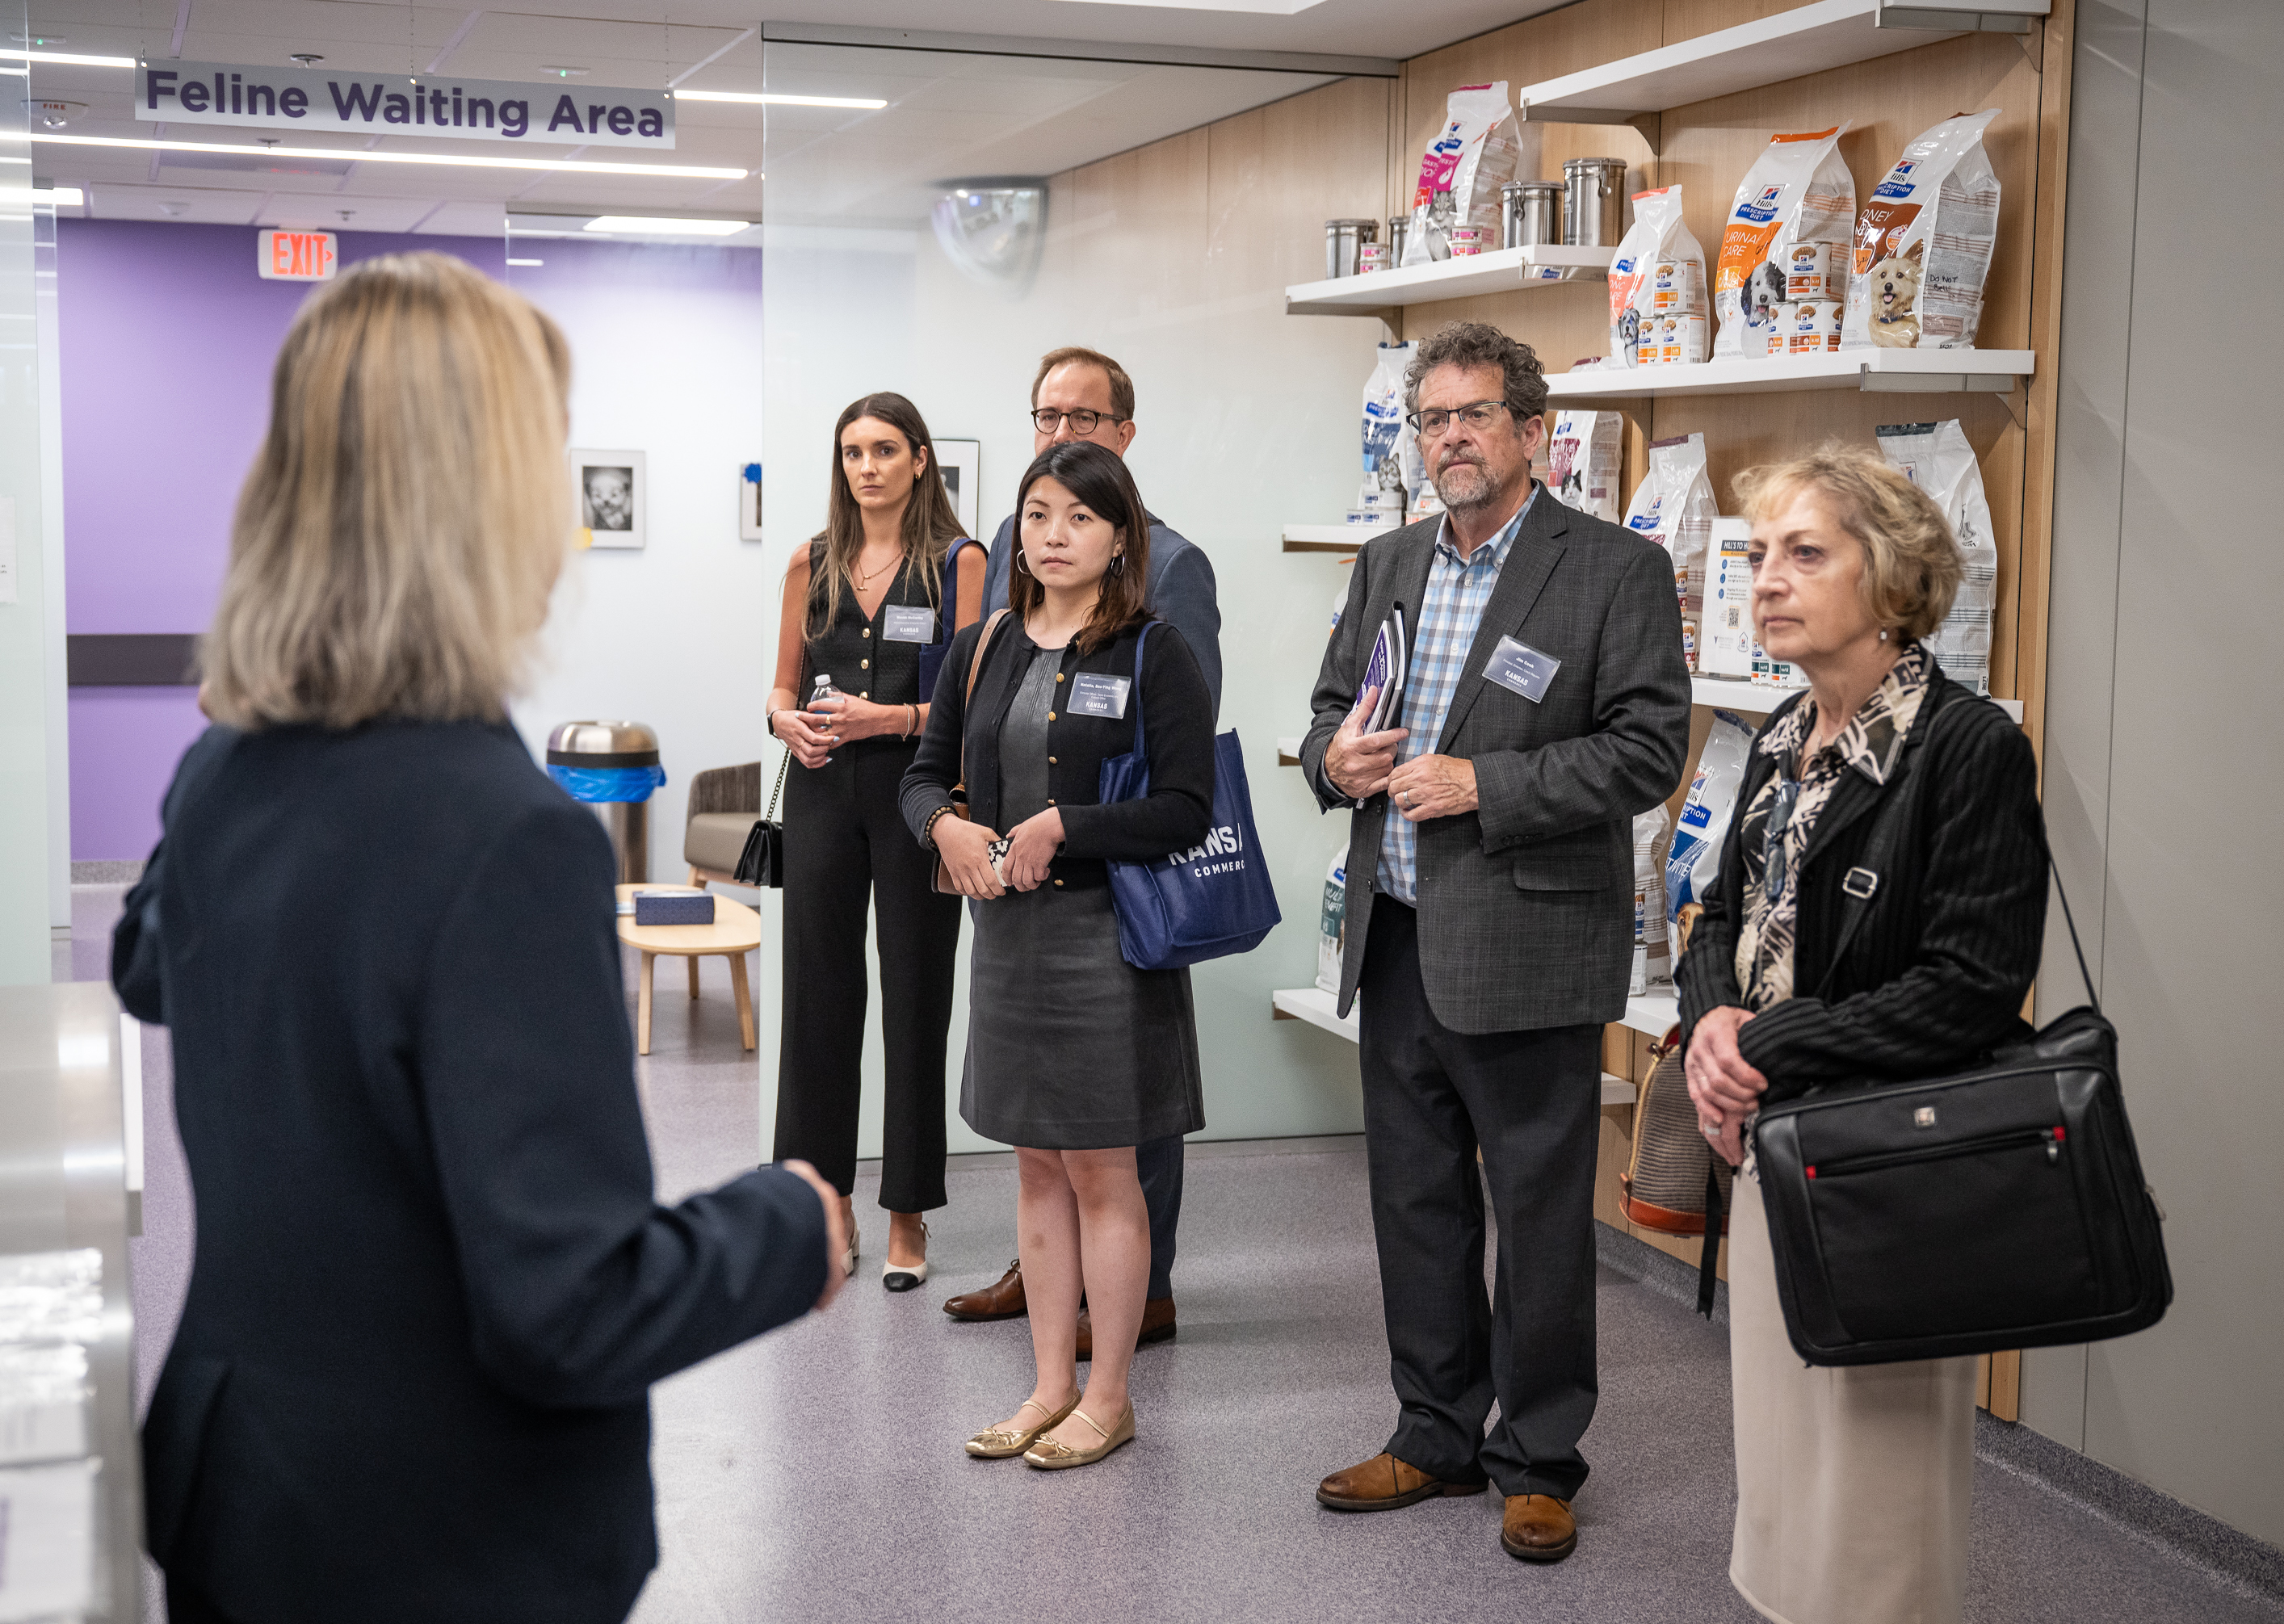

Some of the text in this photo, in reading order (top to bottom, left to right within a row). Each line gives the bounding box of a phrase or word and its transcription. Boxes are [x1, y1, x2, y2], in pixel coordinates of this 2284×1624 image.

[147, 69, 663, 137] Feline Waiting Area
[1756, 199, 1774, 208] Hill's
[272, 231, 326, 278] EXIT
[1723, 541, 1736, 550] HILL'S
[1737, 542, 1743, 550] TO
[1505, 669, 1529, 686] KANSAS
[1085, 701, 1108, 710] KANSAS
